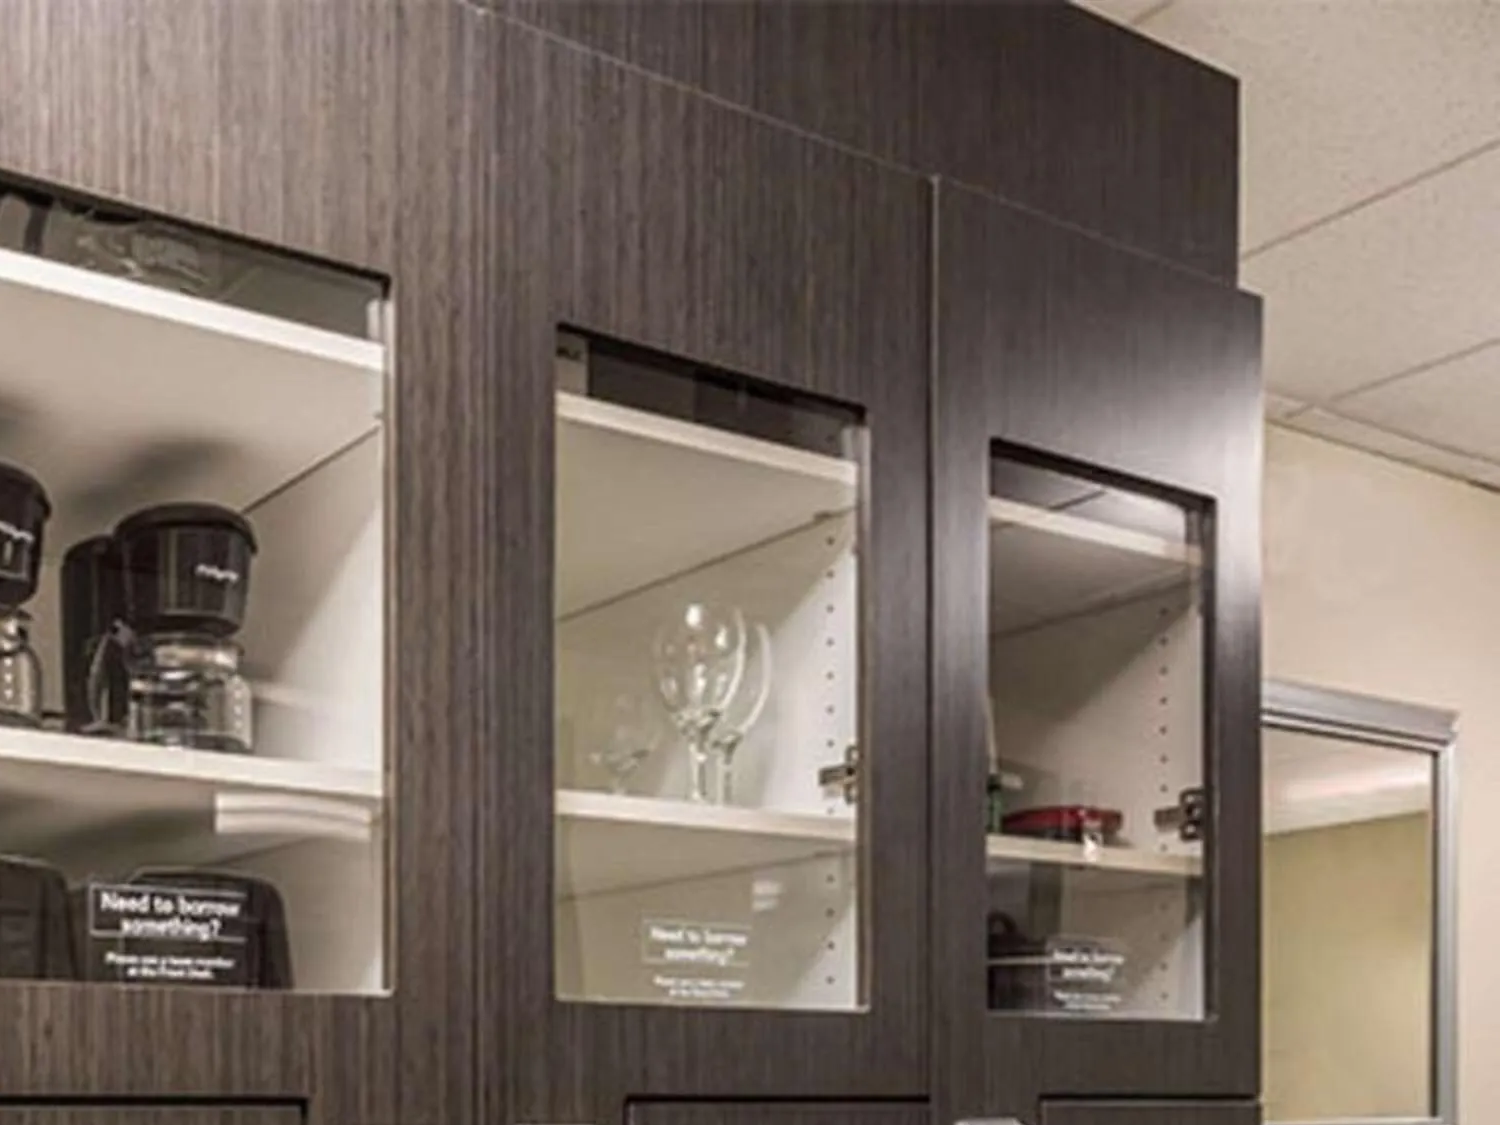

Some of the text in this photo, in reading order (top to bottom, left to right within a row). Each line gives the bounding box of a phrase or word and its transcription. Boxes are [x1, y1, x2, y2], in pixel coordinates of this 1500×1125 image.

[100, 892, 241, 917] Need to borrow
